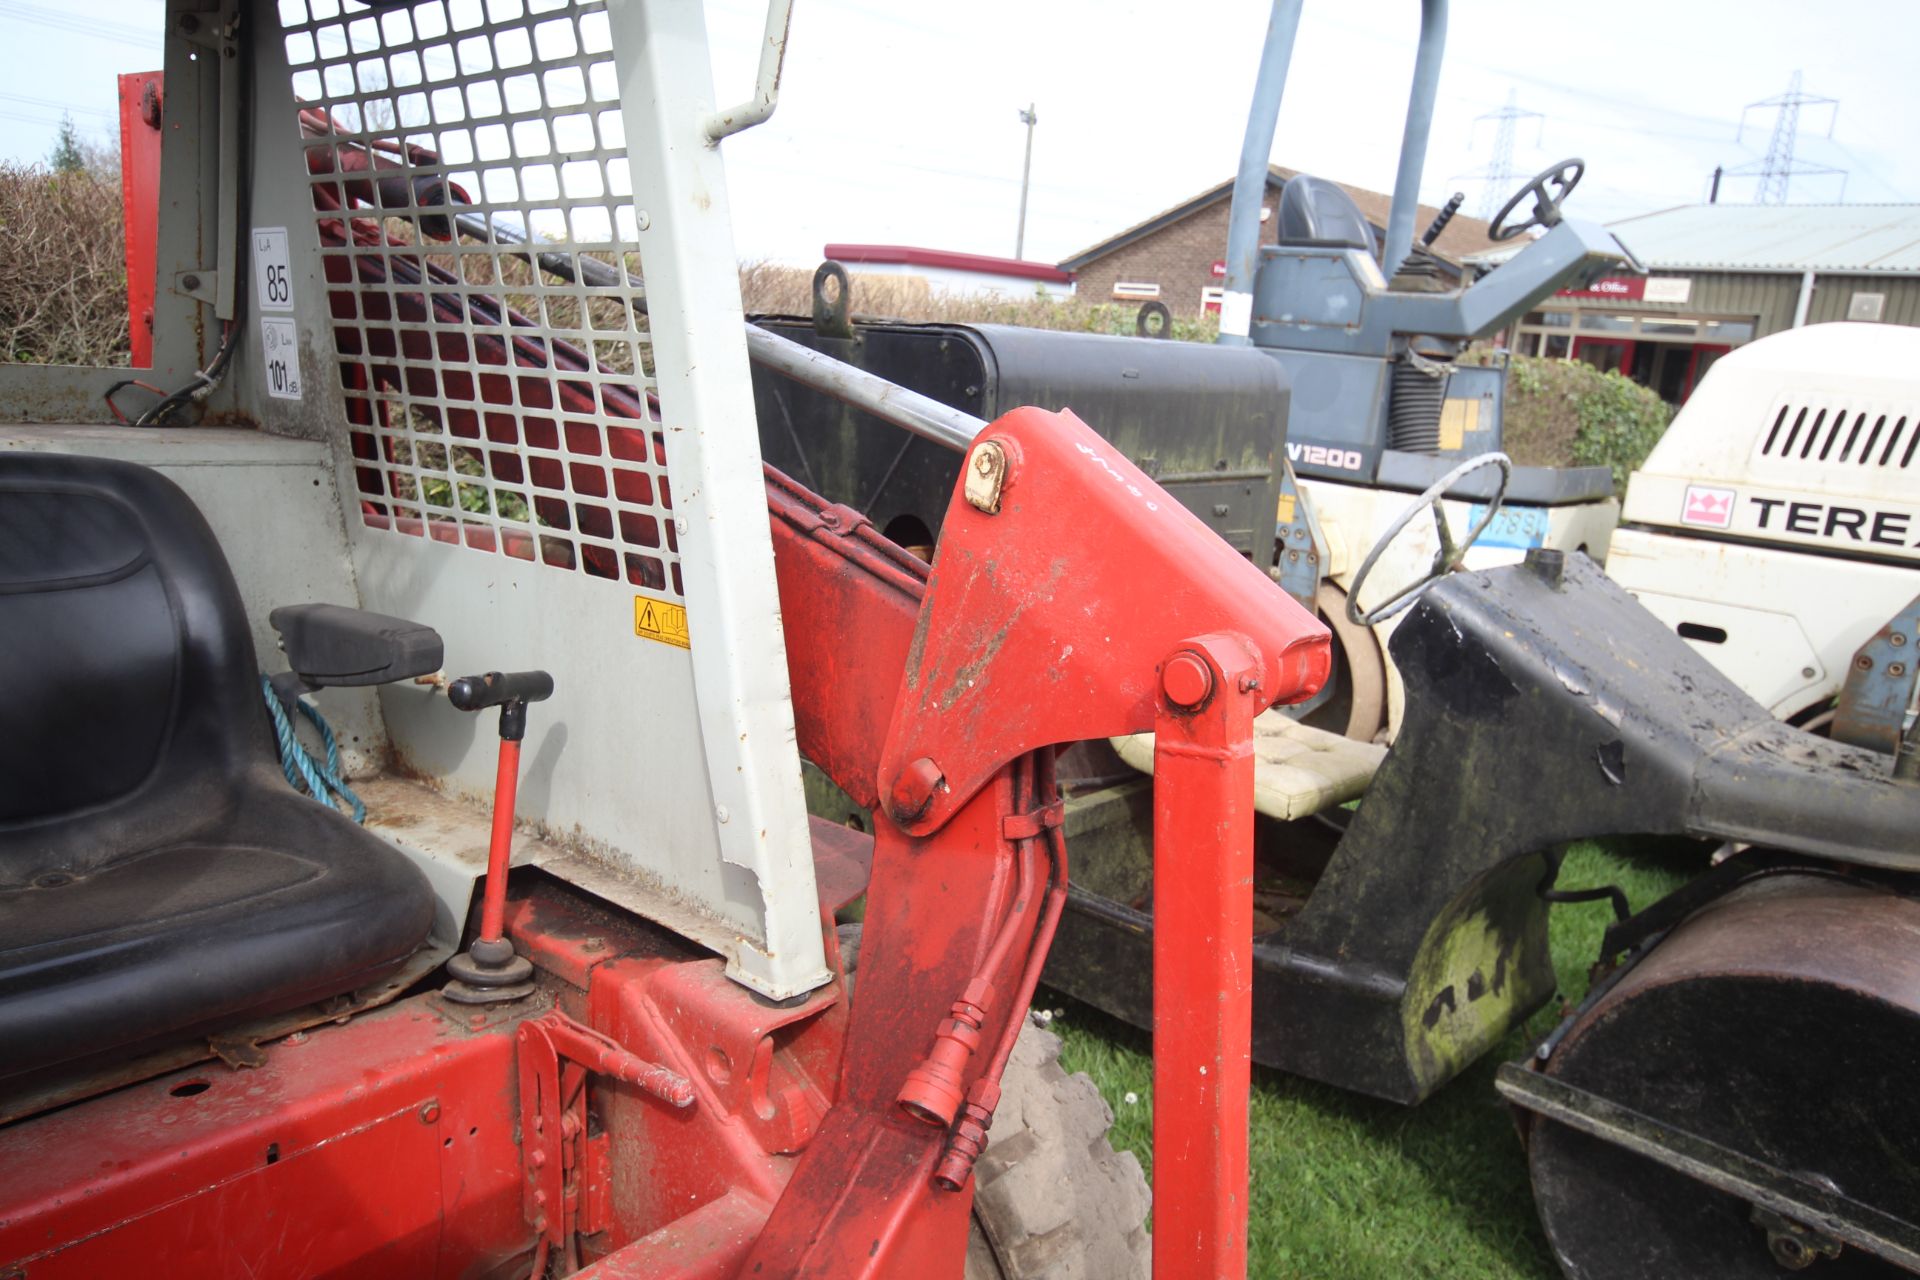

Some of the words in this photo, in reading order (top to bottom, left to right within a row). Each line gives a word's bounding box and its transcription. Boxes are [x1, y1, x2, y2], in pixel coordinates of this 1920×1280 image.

[267, 265, 288, 302] 85
[269, 359, 288, 392] 101
[1285, 442, 1362, 471] V1200
[1750, 497, 1920, 548] TERE
